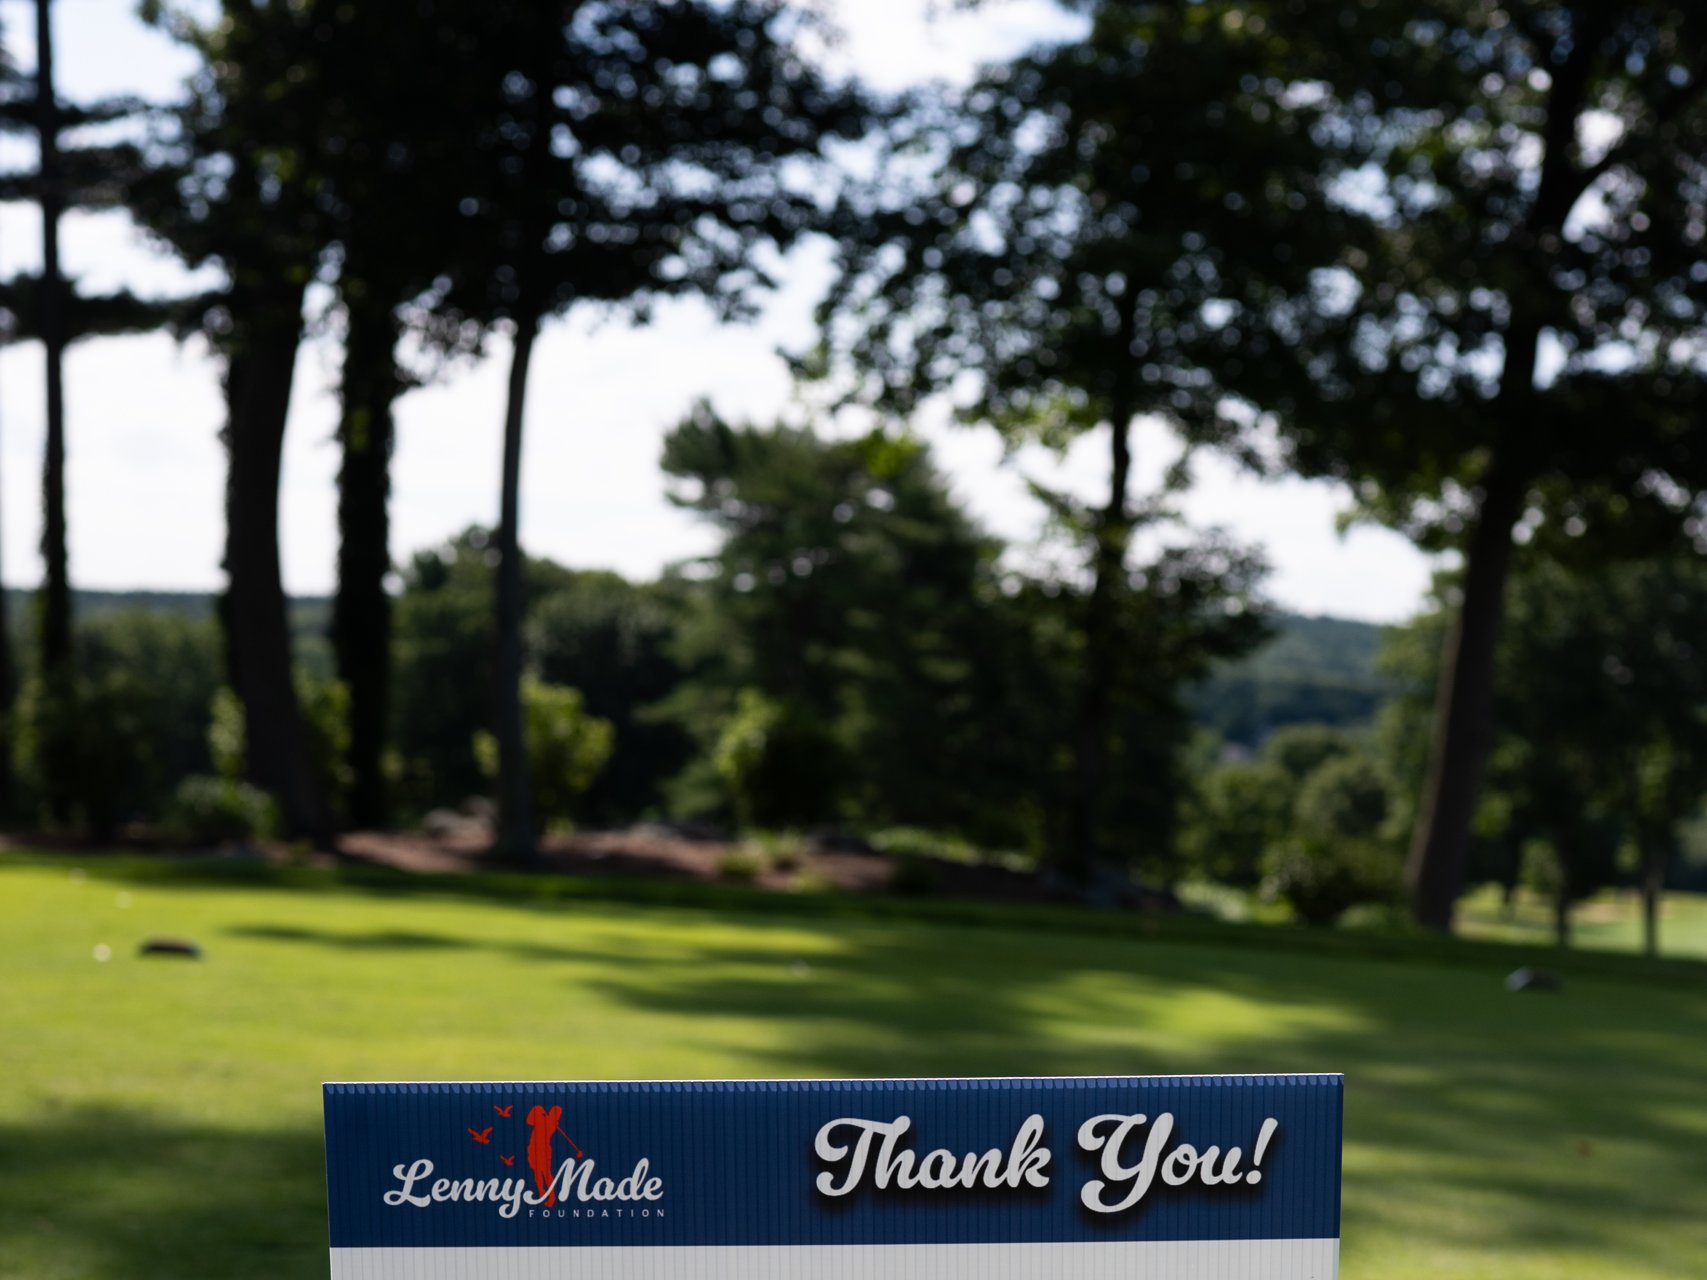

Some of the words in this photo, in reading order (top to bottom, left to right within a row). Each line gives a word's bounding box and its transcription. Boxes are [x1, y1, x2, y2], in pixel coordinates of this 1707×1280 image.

[814, 1113, 1052, 1196] Thank
[1077, 1112, 1279, 1213] You!
[528, 1208, 665, 1218] FOUNDATION
